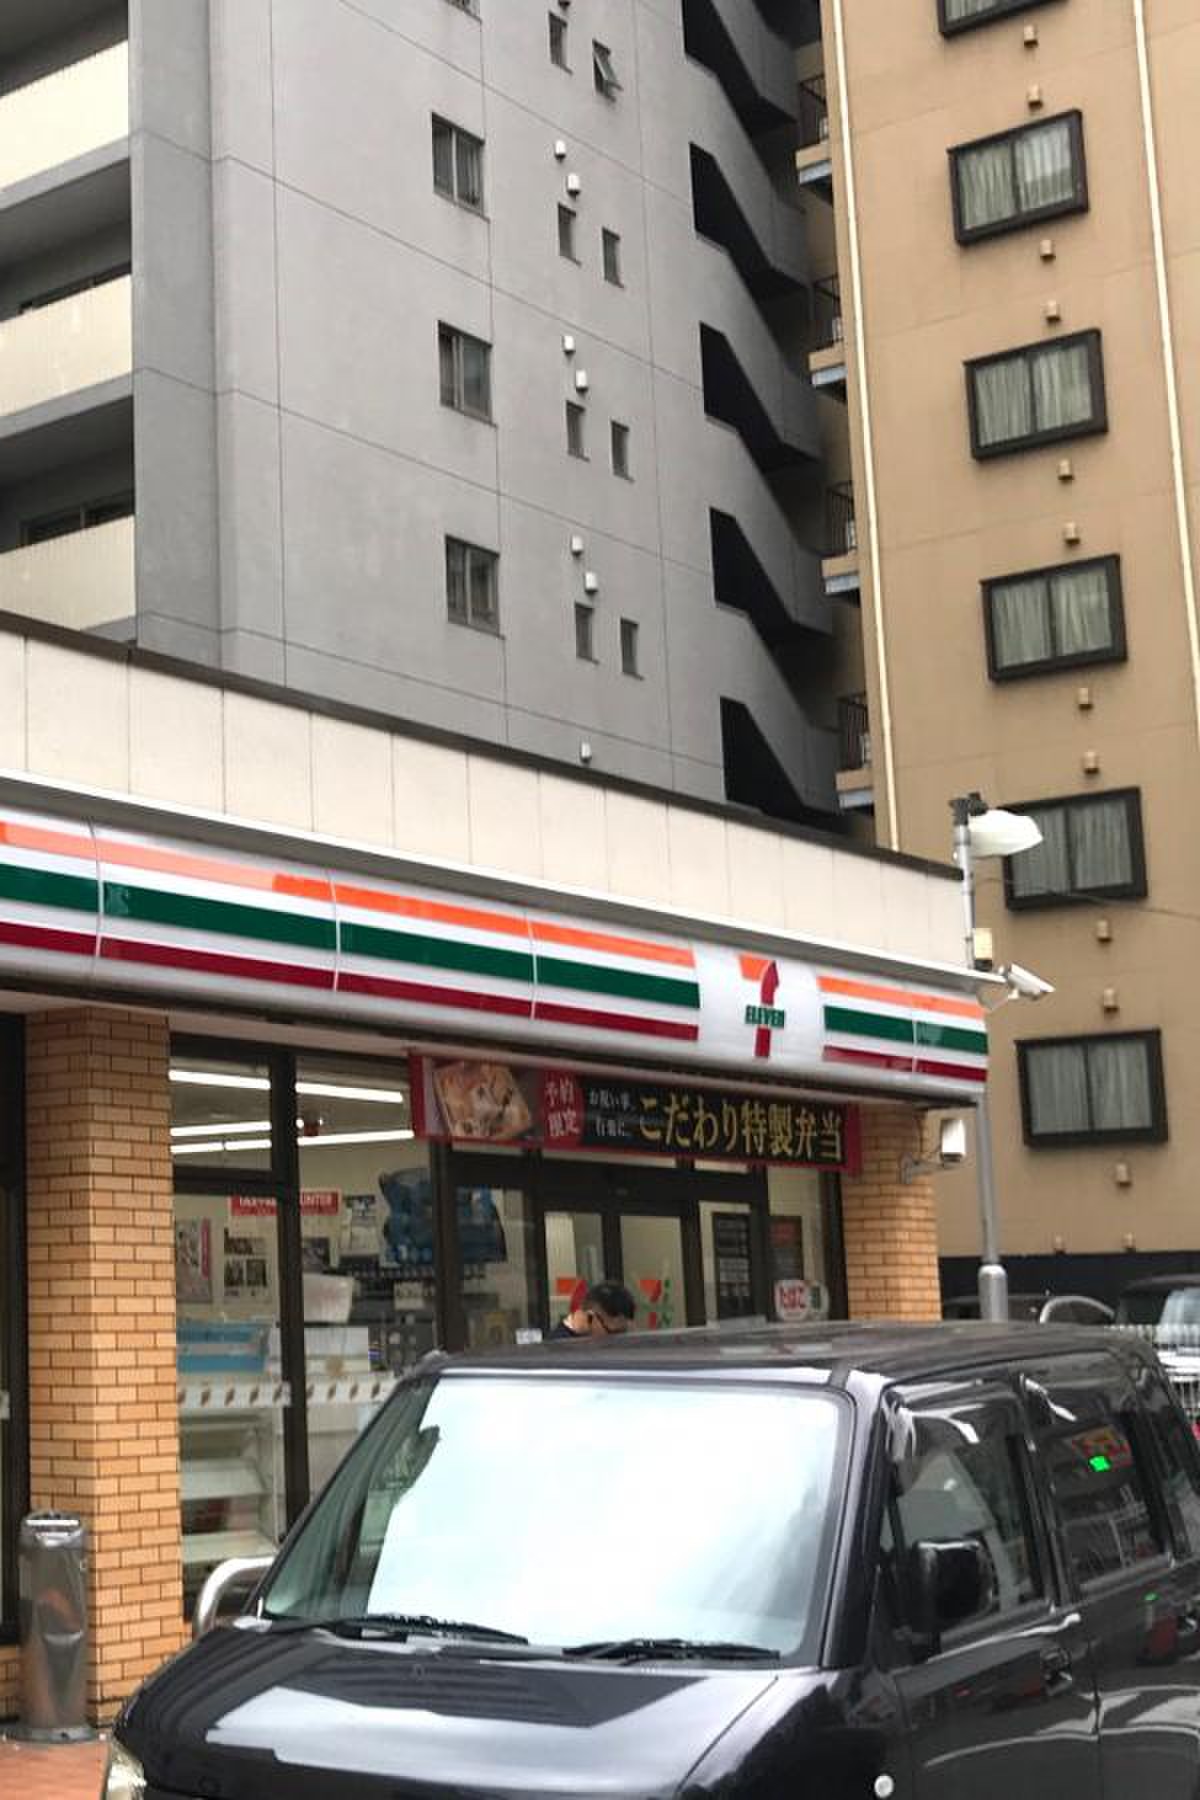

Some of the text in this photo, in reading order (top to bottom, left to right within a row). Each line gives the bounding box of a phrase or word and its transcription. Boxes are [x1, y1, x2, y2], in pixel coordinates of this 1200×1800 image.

[639, 1093, 842, 1161] こだわり特製弁当
